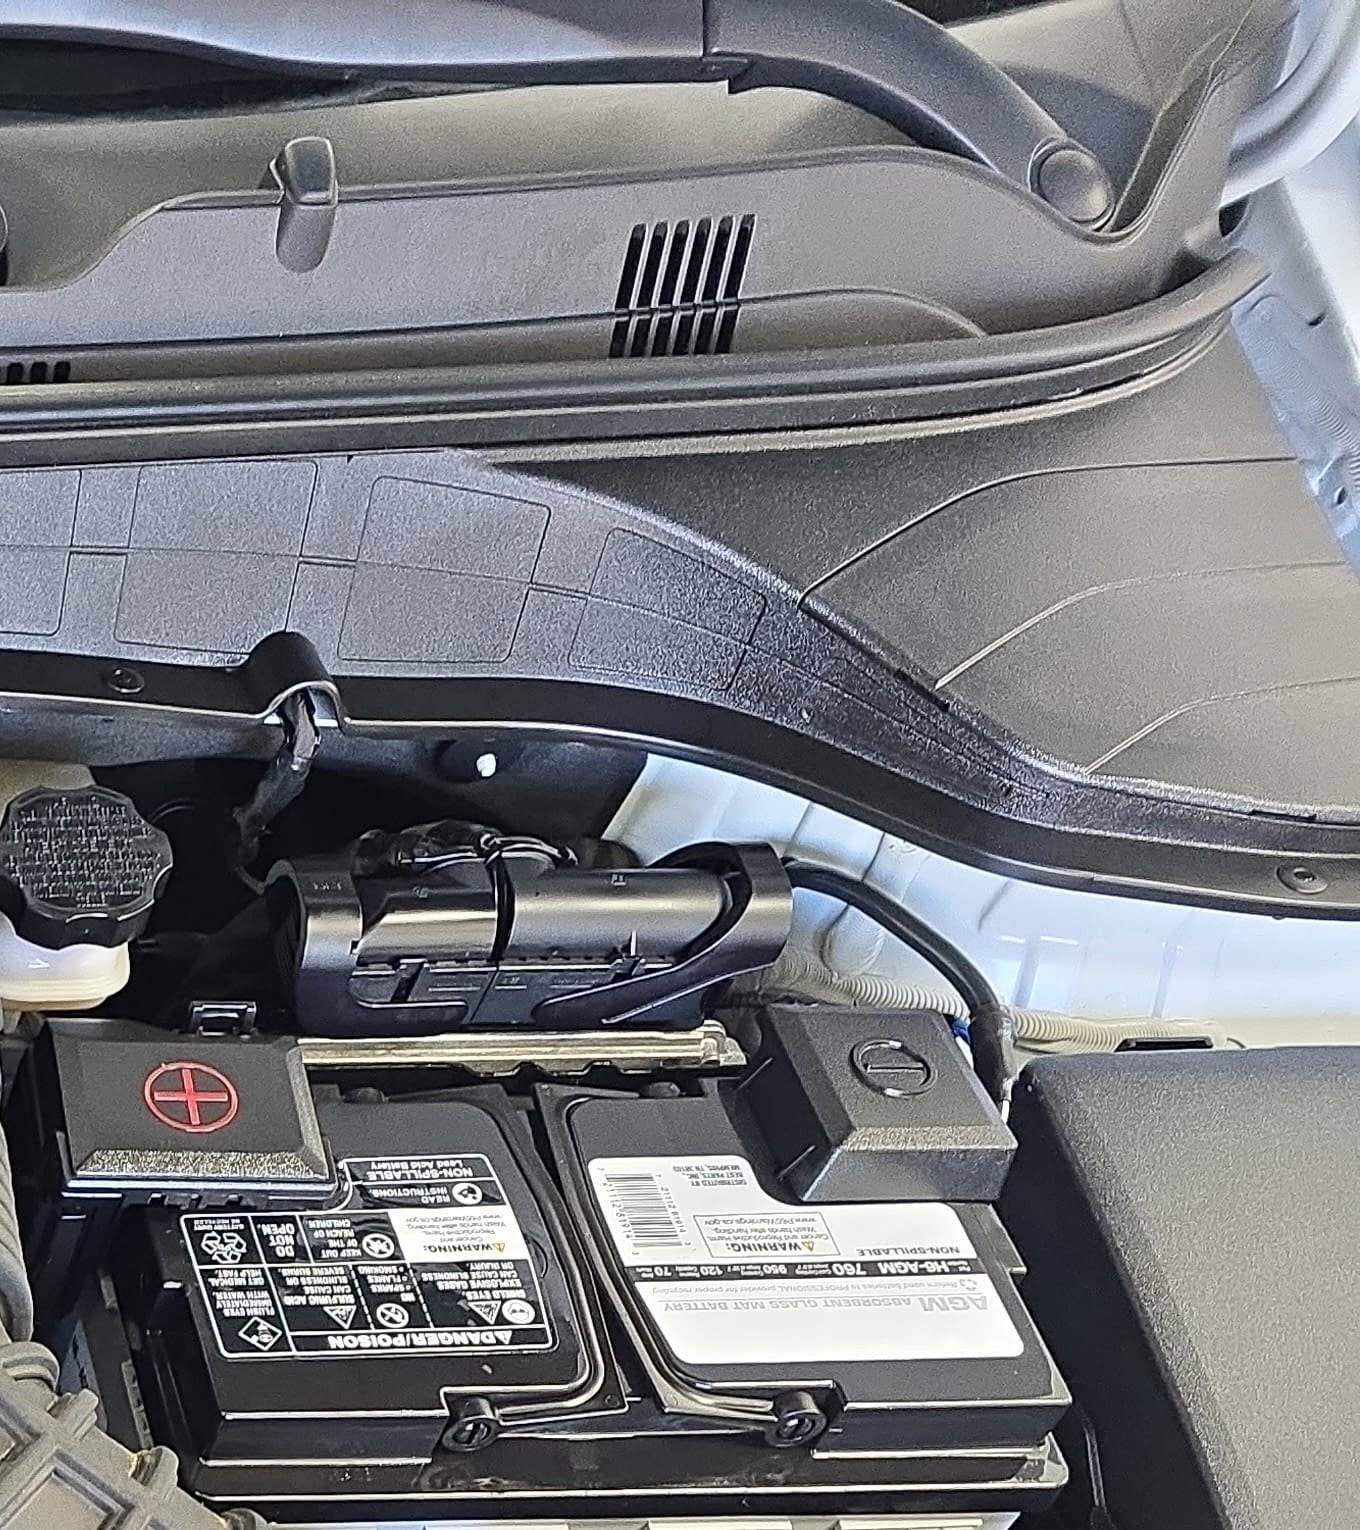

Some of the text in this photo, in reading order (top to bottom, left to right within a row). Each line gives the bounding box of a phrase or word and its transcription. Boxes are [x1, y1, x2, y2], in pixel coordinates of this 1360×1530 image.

[370, 1160, 463, 1171] Lead Acid Battery
[366, 1166, 473, 1181] NON-SPILLABLE
[421, 1195, 450, 1204] READ
[325, 1229, 354, 1238] REACH
[268, 1234, 295, 1246] NOT
[275, 1246, 295, 1257] DO
[423, 1242, 492, 1253] WARNING:
[725, 1242, 802, 1253] WARNING:
[855, 1245, 960, 1257] NON-SPILLABLE
[320, 1249, 338, 1258] OUT
[312, 1266, 345, 1275] SEVERE
[654, 1266, 672, 1277] 70
[700, 1265, 723, 1276] 120
[763, 1264, 788, 1275] 950
[831, 1263, 866, 1276] 760
[300, 1276, 348, 1286] BLINDNESS
[421, 1270, 518, 1281] CAN CAUSE BLINDNESS
[303, 1284, 352, 1294] CAN CAUSE
[469, 1278, 521, 1289] EXPLOSIVE
[284, 1294, 355, 1305] SULFURIC ACID
[401, 1292, 416, 1302] NO
[664, 1295, 987, 1312] AGM ABSORBENT GLASS MAT BATTERY
[328, 1331, 496, 1349] DANGER/POISON
